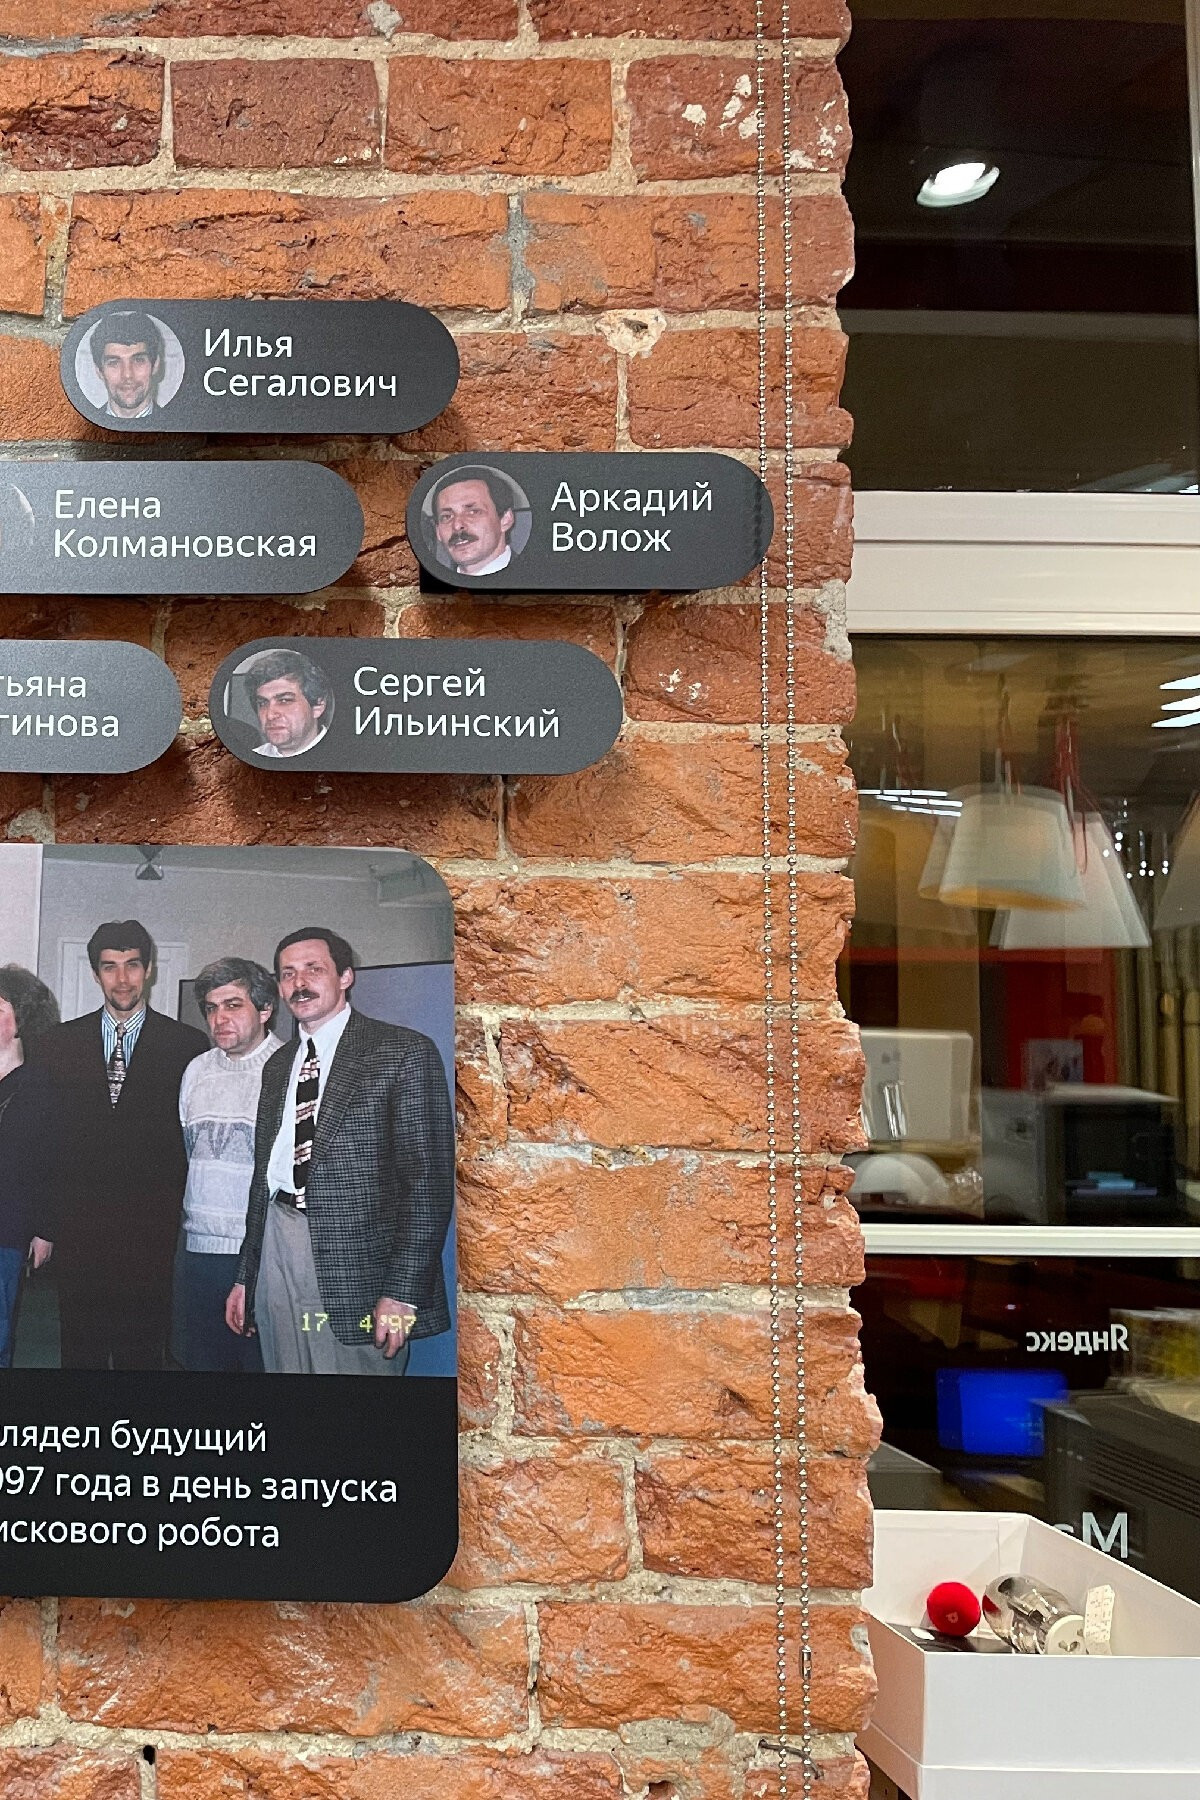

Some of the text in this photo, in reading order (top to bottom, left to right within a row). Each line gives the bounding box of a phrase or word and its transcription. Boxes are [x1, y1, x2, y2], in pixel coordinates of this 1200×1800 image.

[204, 328, 293, 358] Илья
[203, 366, 397, 397] Сегалович
[55, 489, 161, 519] Елена
[550, 481, 713, 518] Аркадий
[54, 528, 317, 559] Колмановская
[552, 522, 672, 552] Волож
[353, 666, 487, 703] Сергей
[355, 706, 560, 738] Ильинский
[301, 1312, 329, 1332] 17
[111, 1419, 267, 1457] будущий
[56, 1473, 131, 1502] года
[142, 1475, 160, 1497] в
[169, 1476, 252, 1503] день
[261, 1477, 397, 1508] запуска
[158, 1516, 279, 1552] робота
